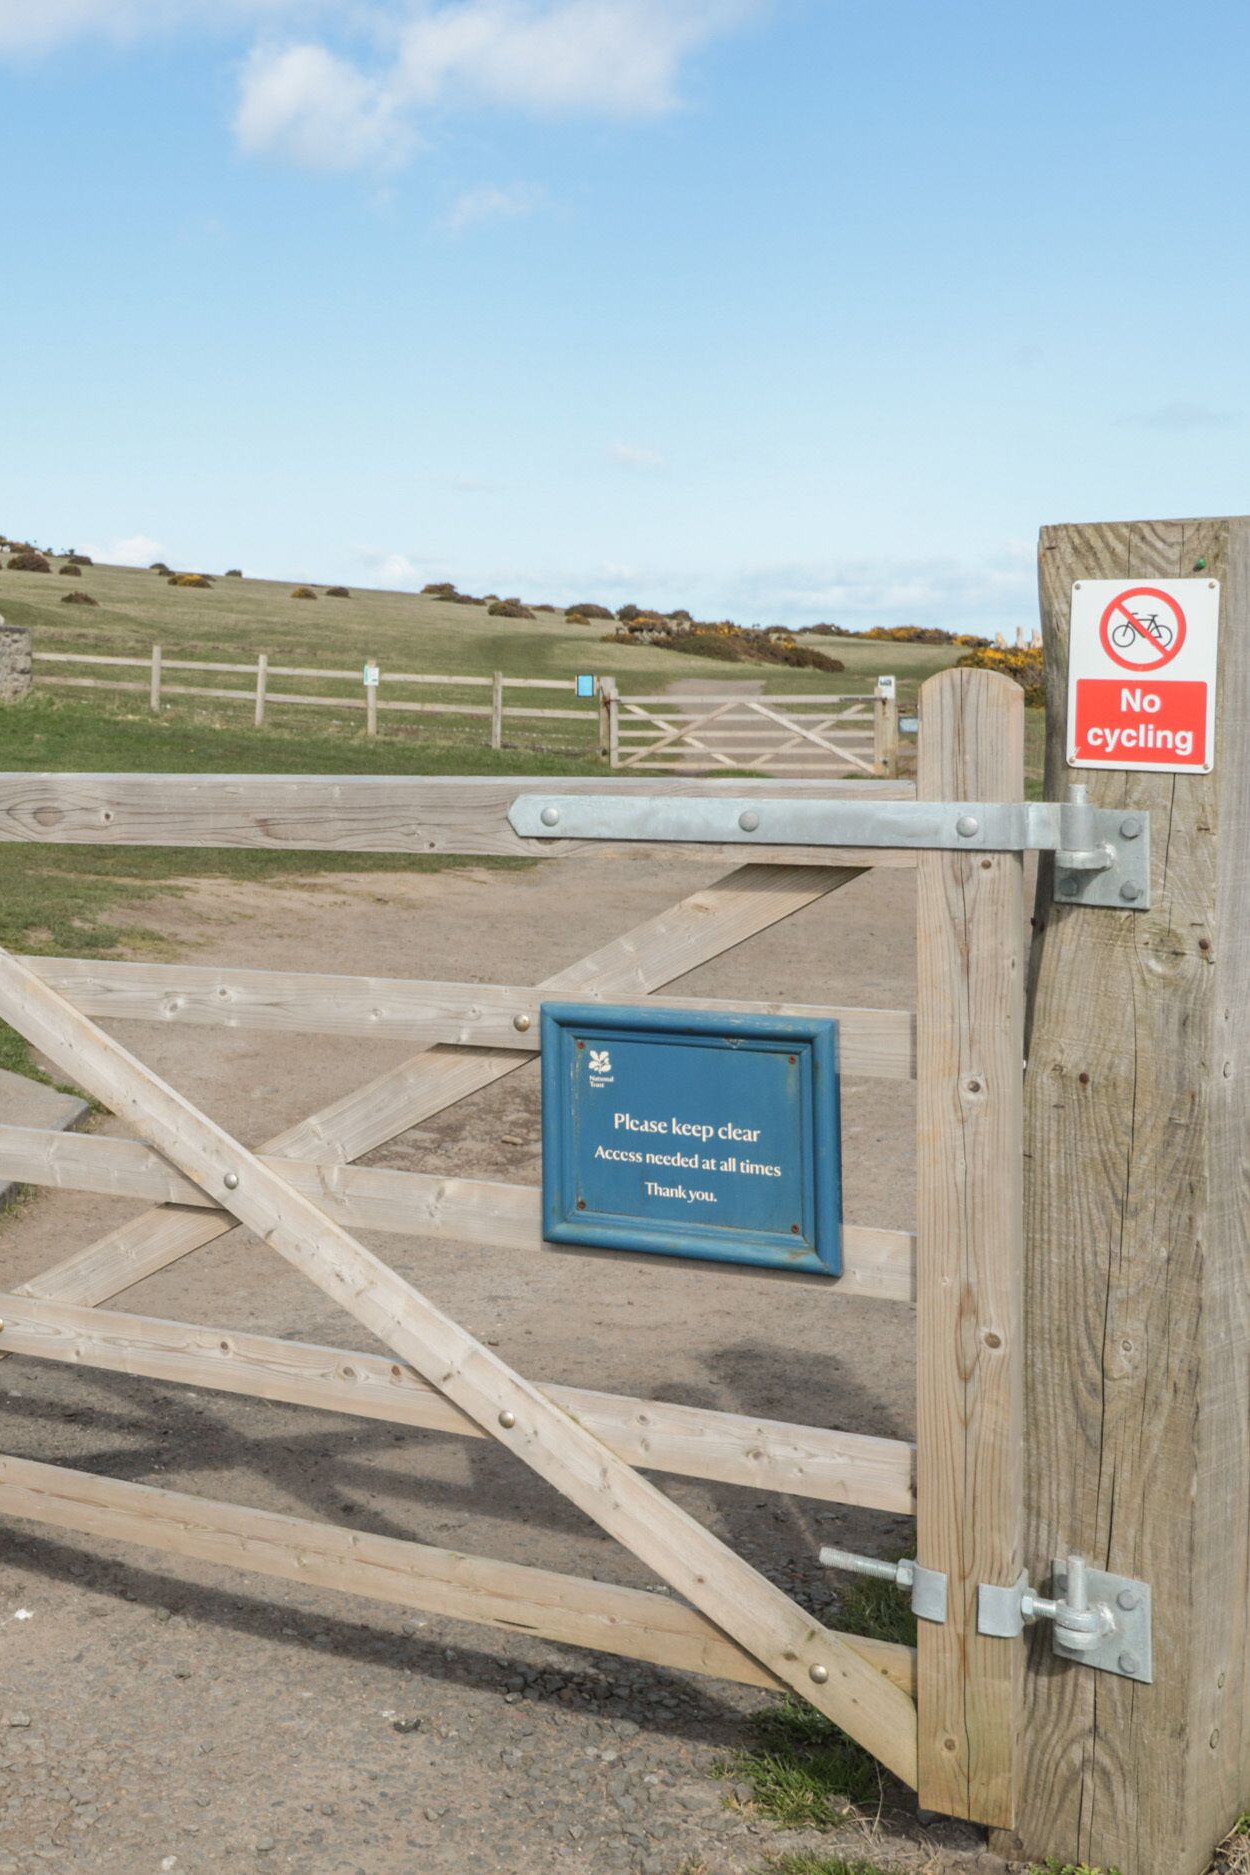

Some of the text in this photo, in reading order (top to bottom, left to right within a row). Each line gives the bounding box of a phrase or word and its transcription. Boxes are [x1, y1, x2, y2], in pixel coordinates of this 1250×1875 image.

[1120, 688, 1162, 713] No
[1087, 724, 1194, 756] cycling
[614, 1113, 761, 1142] Please keep clear
[594, 1145, 781, 1177] Access needed at all times
[645, 1182, 718, 1203] Thank you.
